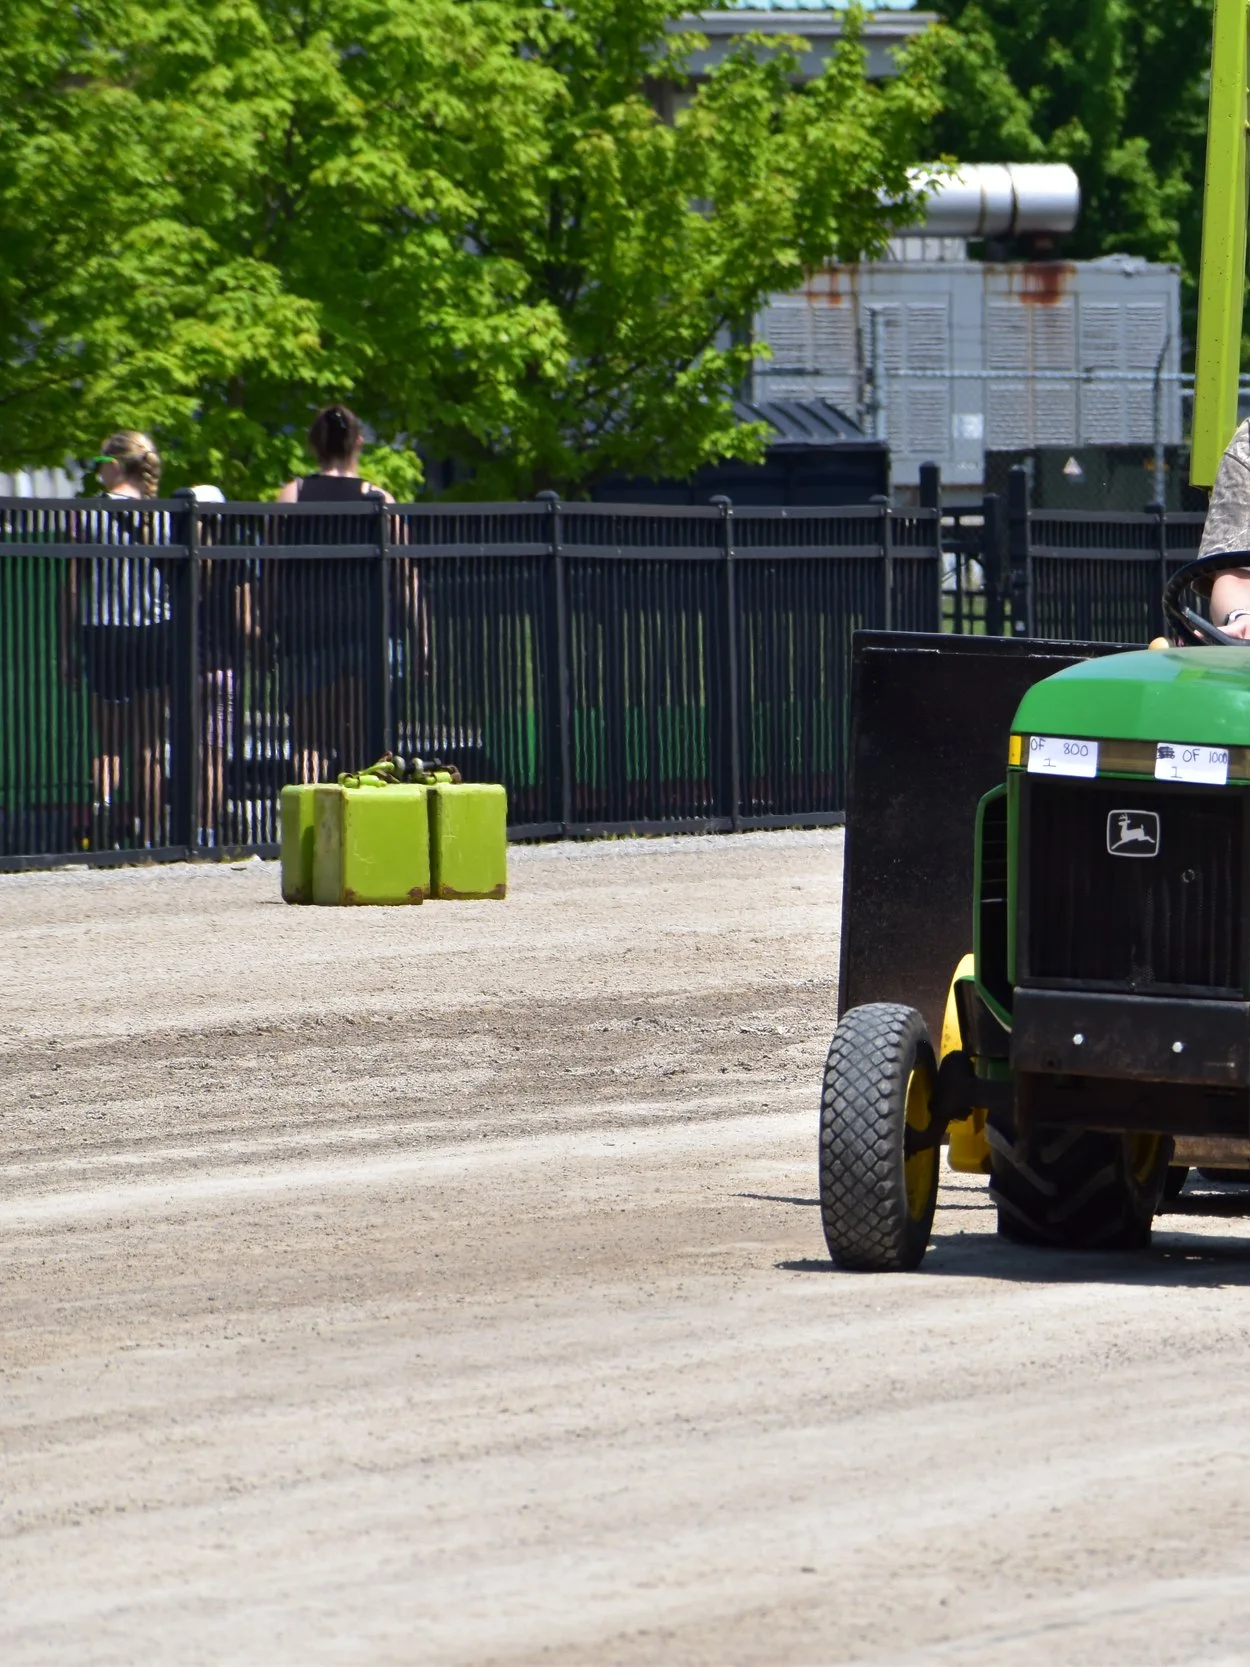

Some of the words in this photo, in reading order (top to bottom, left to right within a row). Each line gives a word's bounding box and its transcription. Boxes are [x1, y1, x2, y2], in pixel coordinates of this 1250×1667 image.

[1030, 738, 1046, 751] OF
[1063, 742, 1089, 757] 800
[1182, 748, 1200, 763] OF
[1208, 751, 1228, 765] 1000
